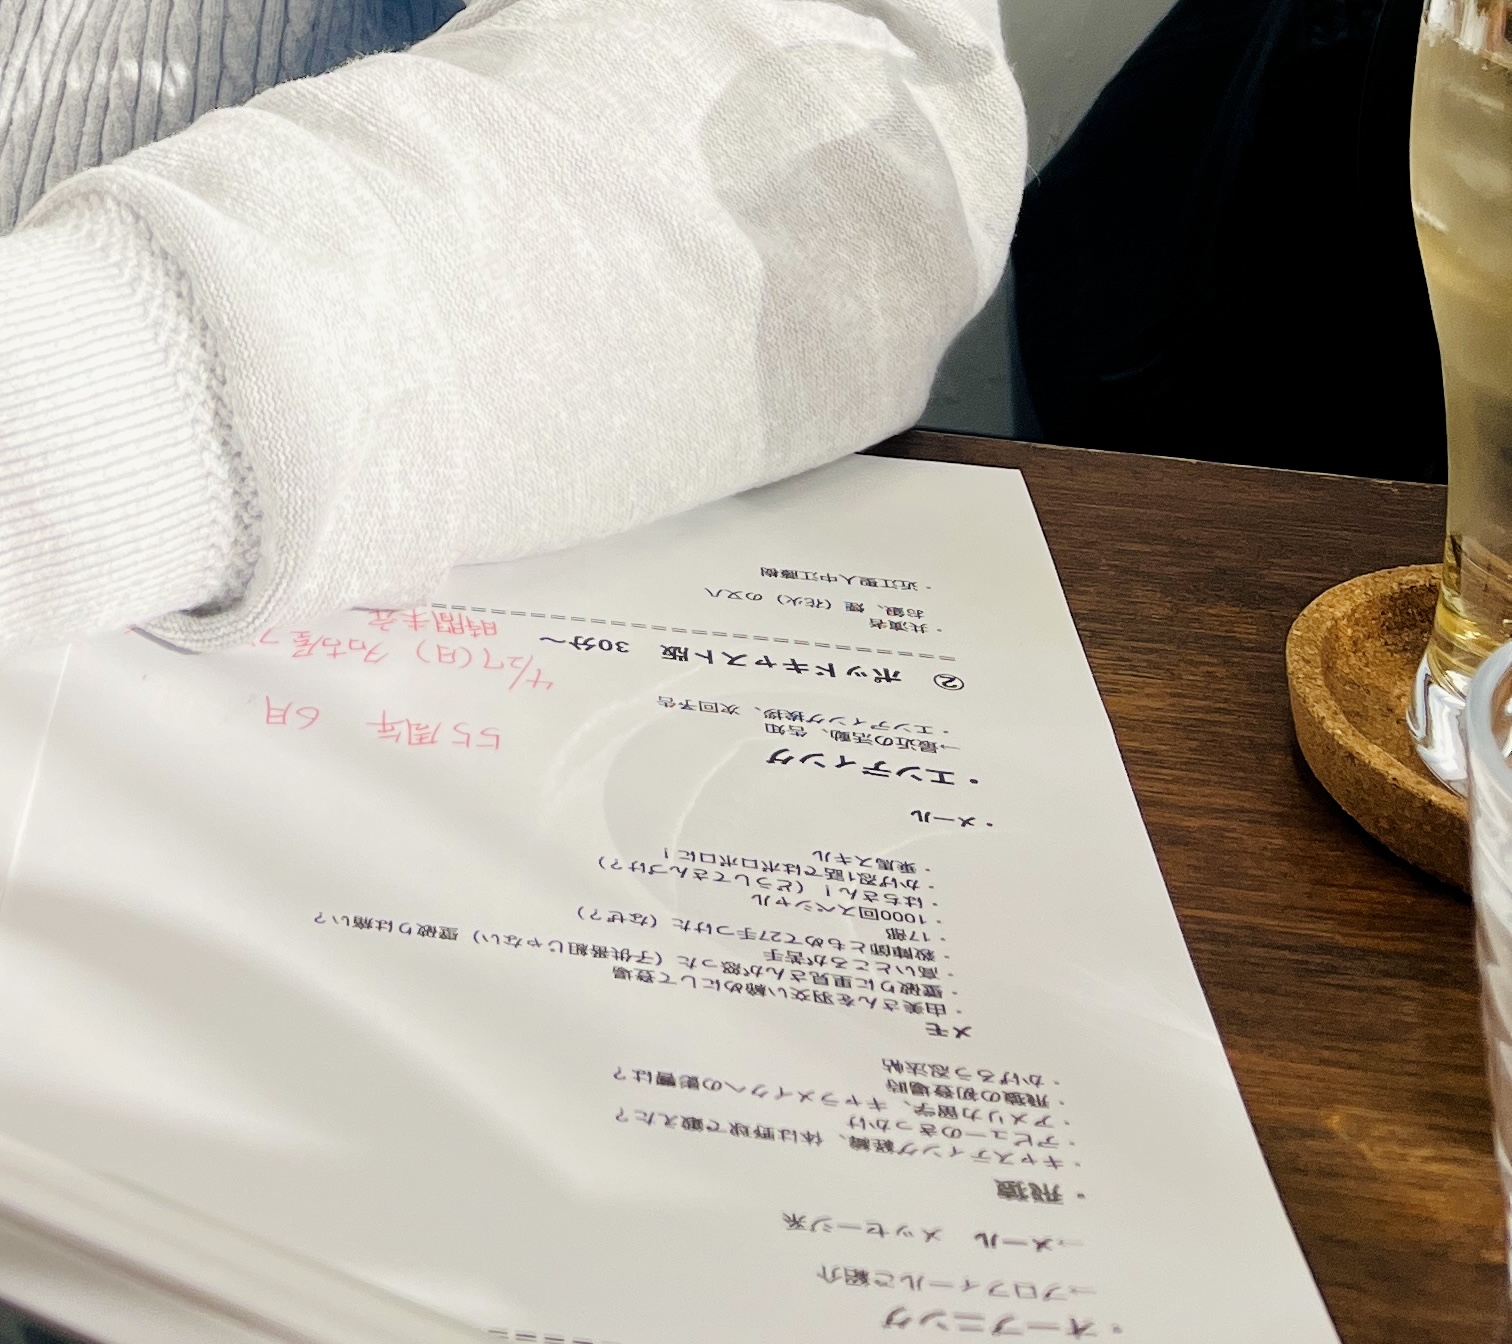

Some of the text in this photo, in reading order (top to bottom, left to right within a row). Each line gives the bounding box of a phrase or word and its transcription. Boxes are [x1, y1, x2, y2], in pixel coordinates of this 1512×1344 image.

[661, 644, 902, 685] ポッドキャスト版
[925, 1022, 973, 1041] メモ
